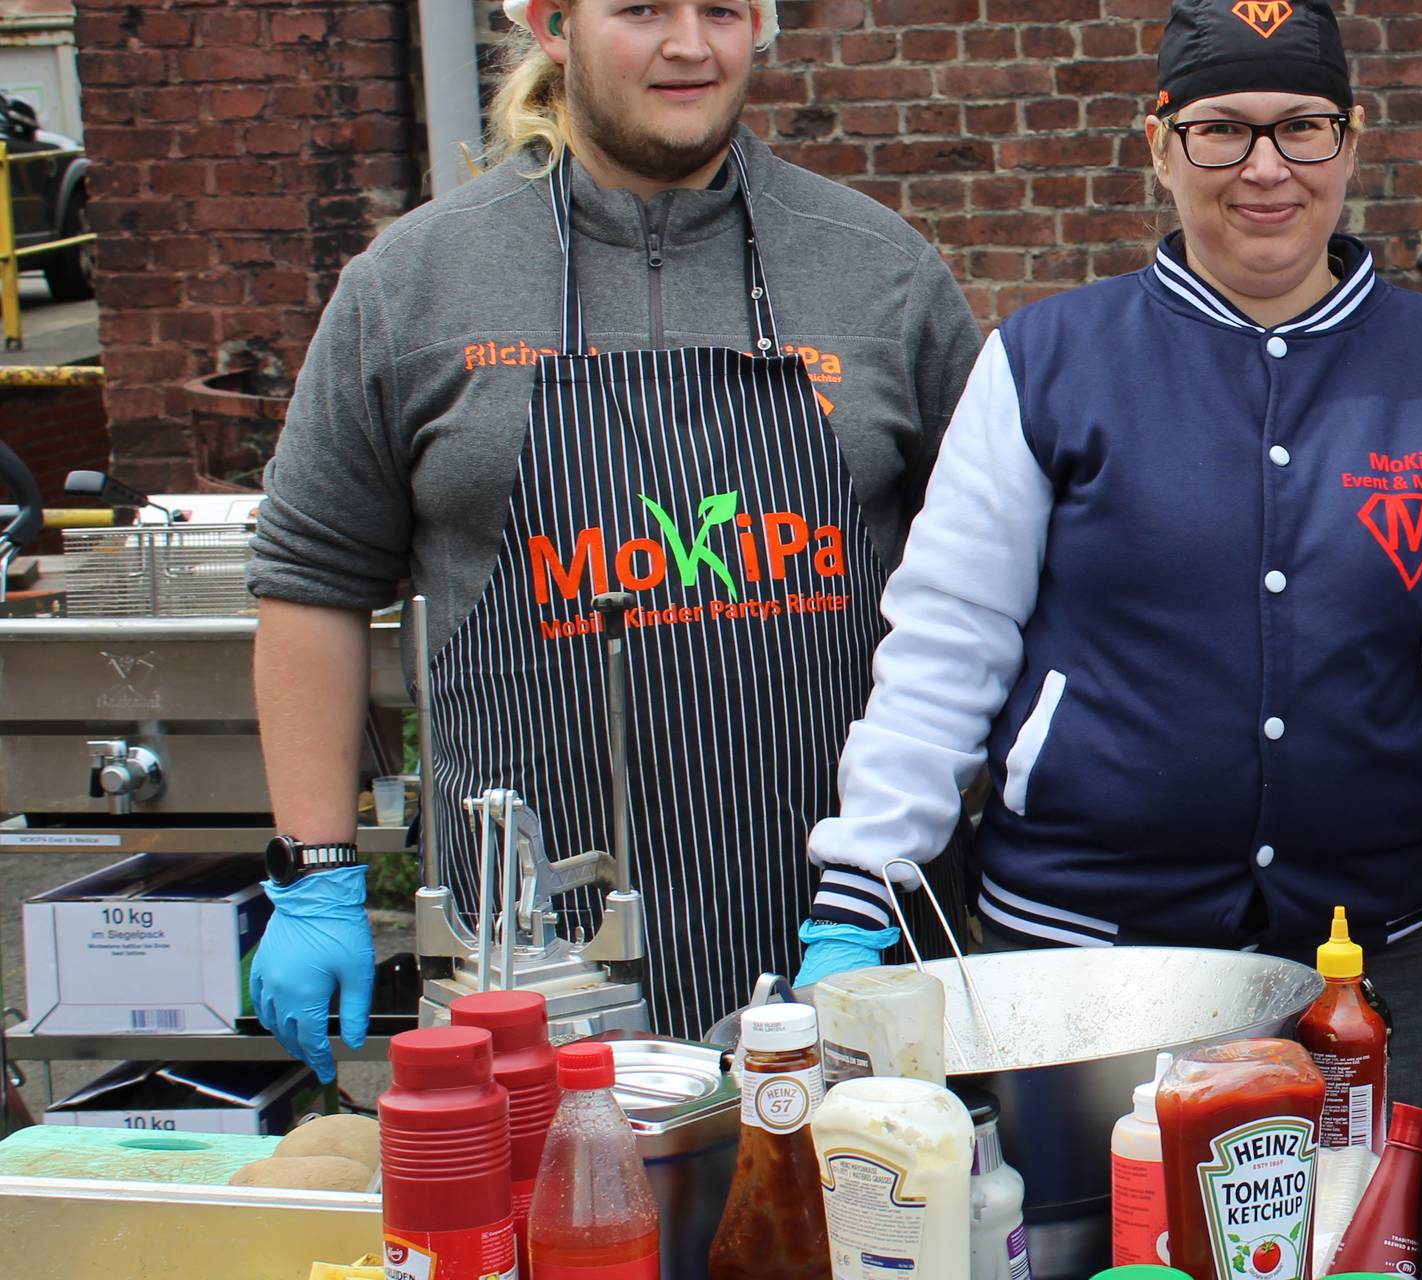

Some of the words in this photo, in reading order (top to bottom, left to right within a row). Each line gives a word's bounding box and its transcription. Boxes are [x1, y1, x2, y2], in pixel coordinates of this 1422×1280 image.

[1342, 473, 1389, 490] Event
[1393, 476, 1409, 490] &
[624, 602, 704, 629] Kinder
[710, 597, 782, 623] Partys
[787, 591, 850, 615] Richter
[102, 908, 124, 925] 10
[128, 907, 154, 929] kg
[766, 1088, 798, 1100] HEINZ
[770, 1099, 793, 1113] 57
[123, 1116, 146, 1130] 10
[1233, 1133, 1300, 1166] HEINZ
[1221, 1170, 1306, 1206] TOMATO
[1227, 1195, 1304, 1226] KETCHUP
[1383, 1239, 1406, 1250] BREWED
